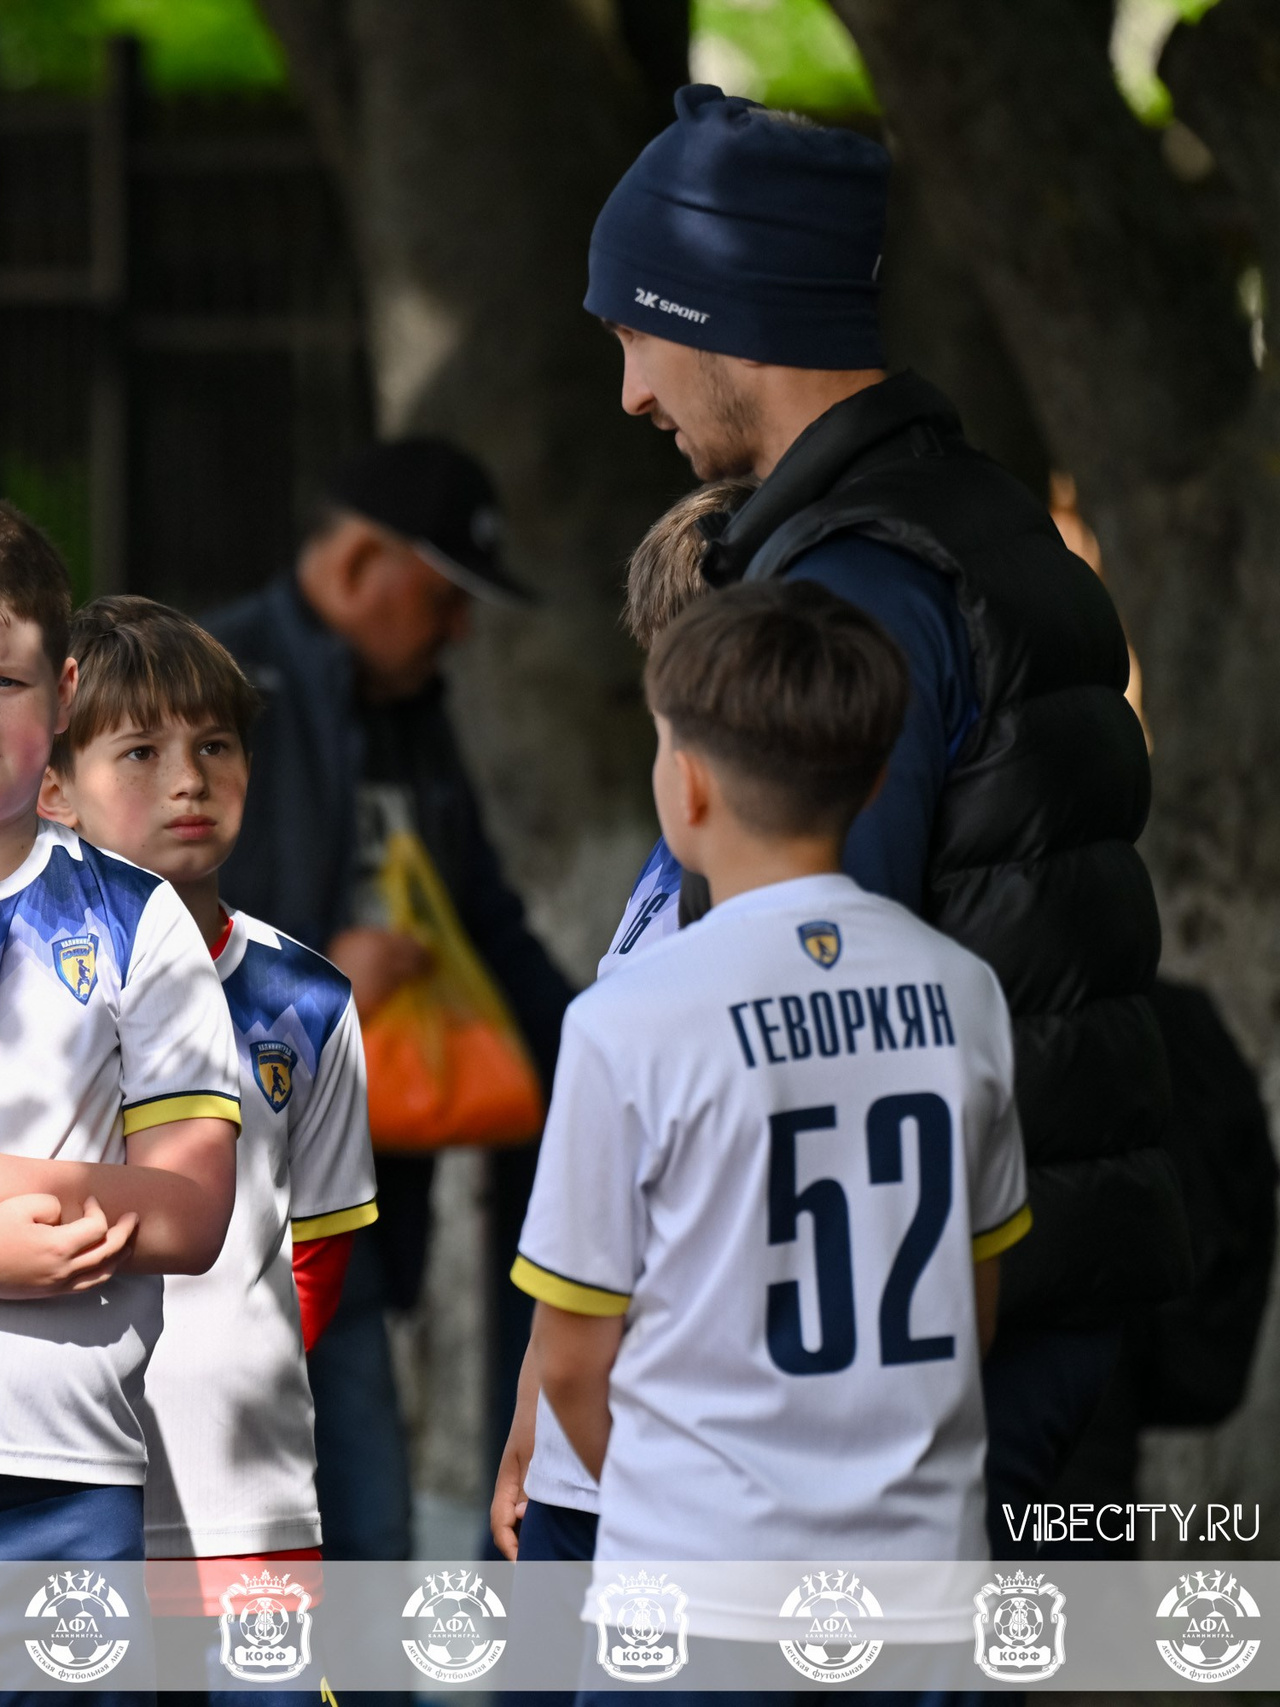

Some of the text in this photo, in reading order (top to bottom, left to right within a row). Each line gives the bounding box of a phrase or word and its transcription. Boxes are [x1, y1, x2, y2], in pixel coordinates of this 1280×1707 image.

[634, 287, 710, 324] 2K SPORT
[613, 893, 670, 955] 16
[729, 983, 956, 1069] ГЕВОРКЯН
[766, 1092, 956, 1376] 52
